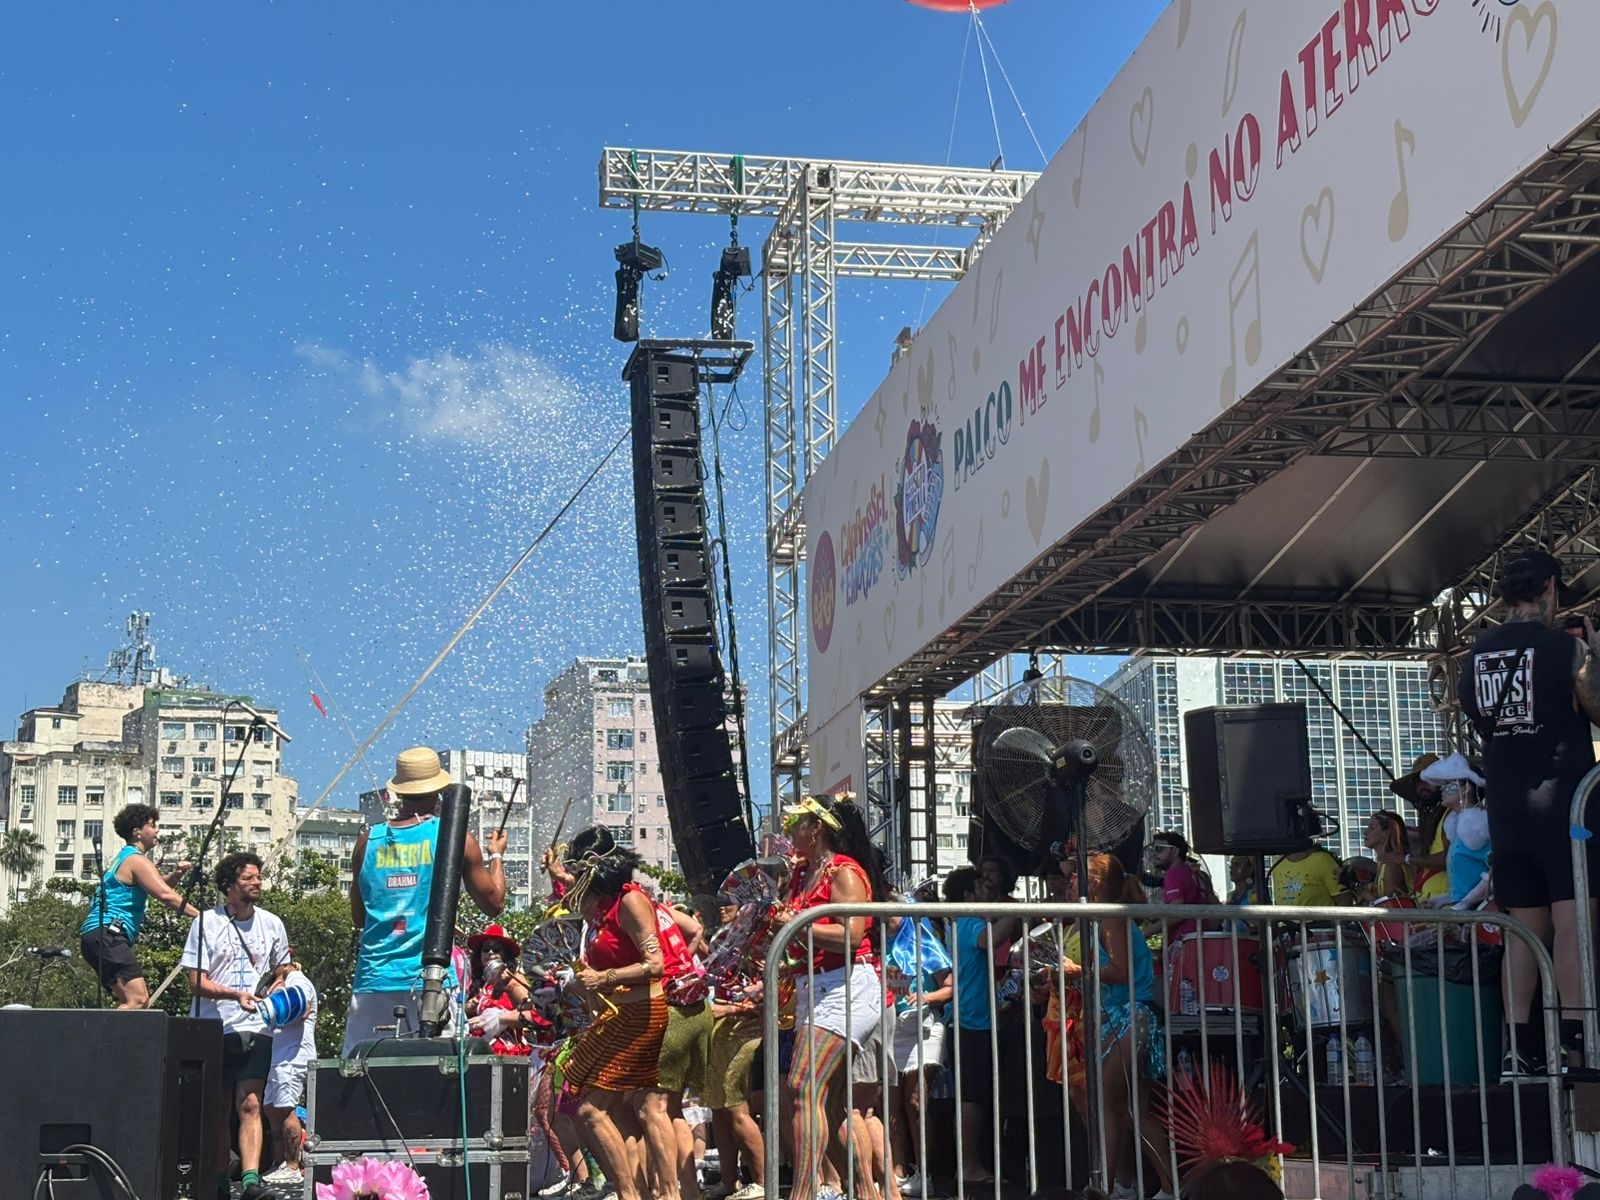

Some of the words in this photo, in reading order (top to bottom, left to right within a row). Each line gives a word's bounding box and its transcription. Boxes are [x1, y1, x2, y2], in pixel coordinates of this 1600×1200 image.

[953, 380, 1012, 491] PALCO
[1018, 335, 1047, 427] ME
[1054, 180, 1200, 390] ENCONTRA
[1209, 112, 1261, 235] NO
[1275, 0, 1441, 170] ATERR
[375, 839, 432, 868] BATERIA
[388, 876, 417, 887] BRAHMA
